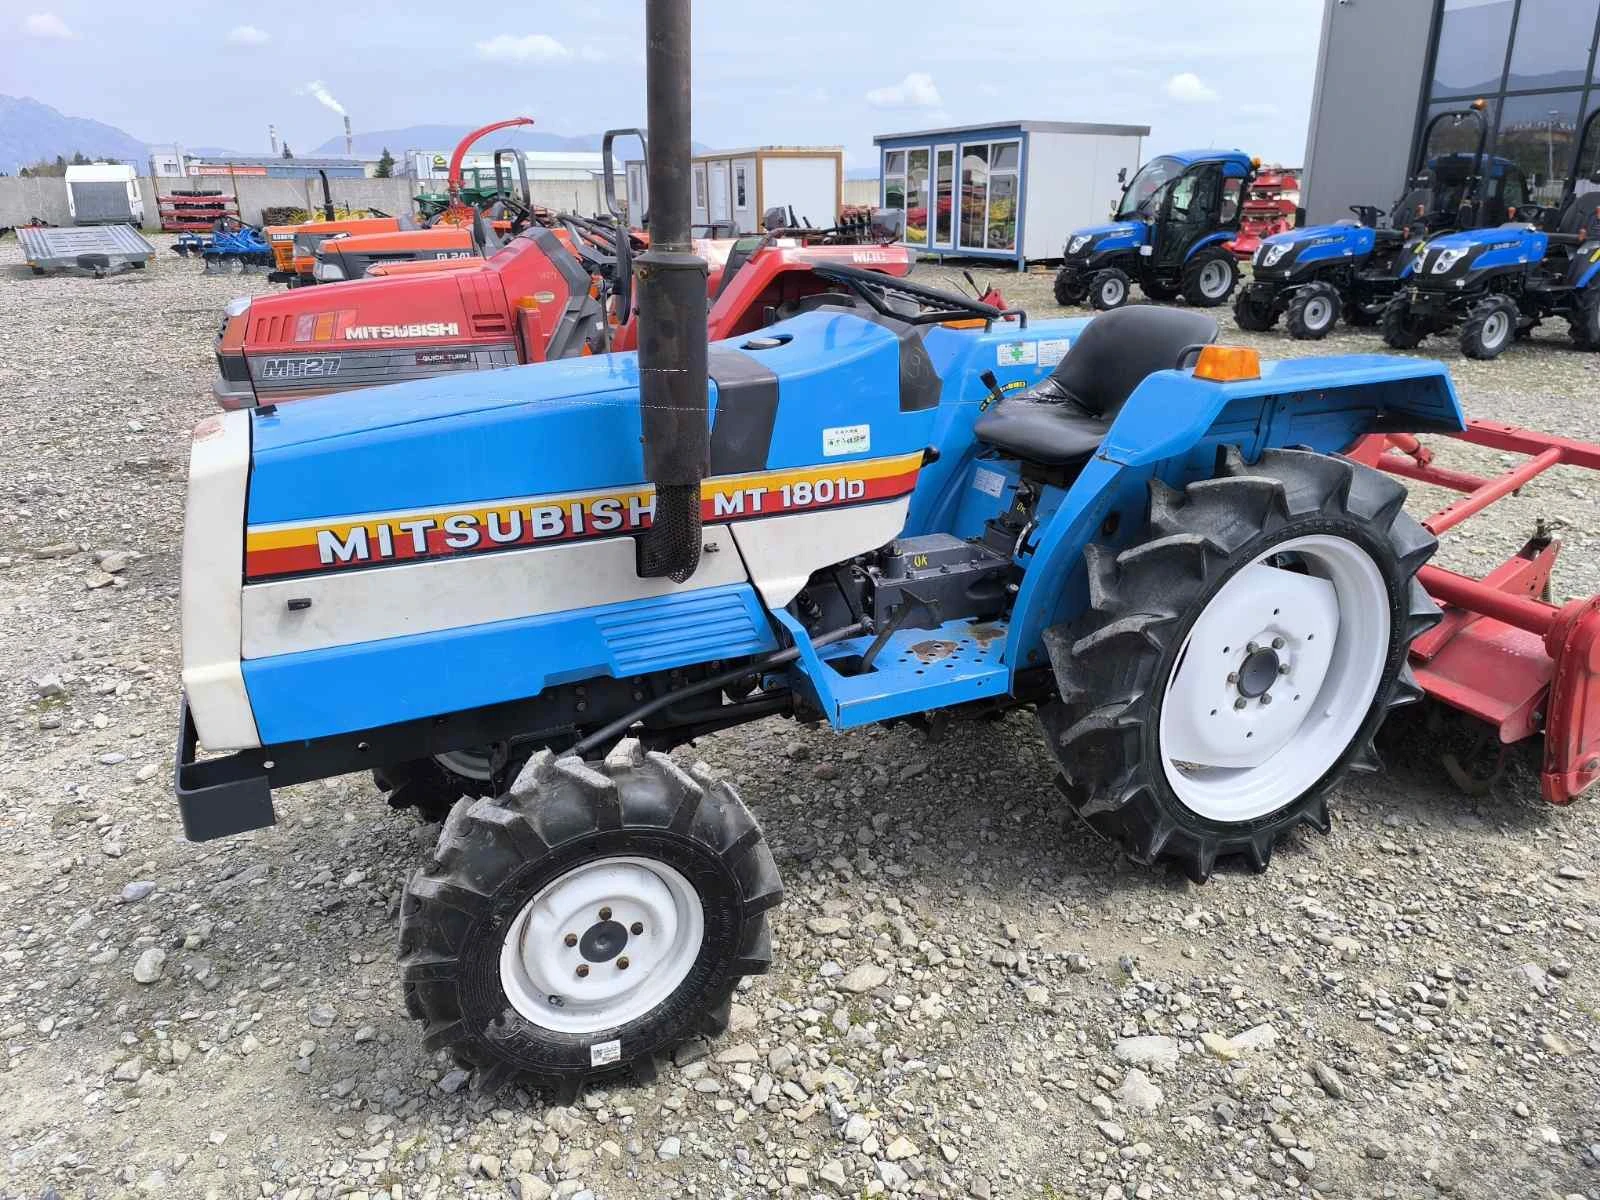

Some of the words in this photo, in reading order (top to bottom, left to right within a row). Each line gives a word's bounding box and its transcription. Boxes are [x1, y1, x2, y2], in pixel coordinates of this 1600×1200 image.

[345, 322, 459, 340] MITSUBISHI
[262, 356, 342, 378] MT27
[713, 487, 768, 516] MT
[780, 476, 866, 508] 1801D
[316, 494, 657, 565] MITSUBISH
